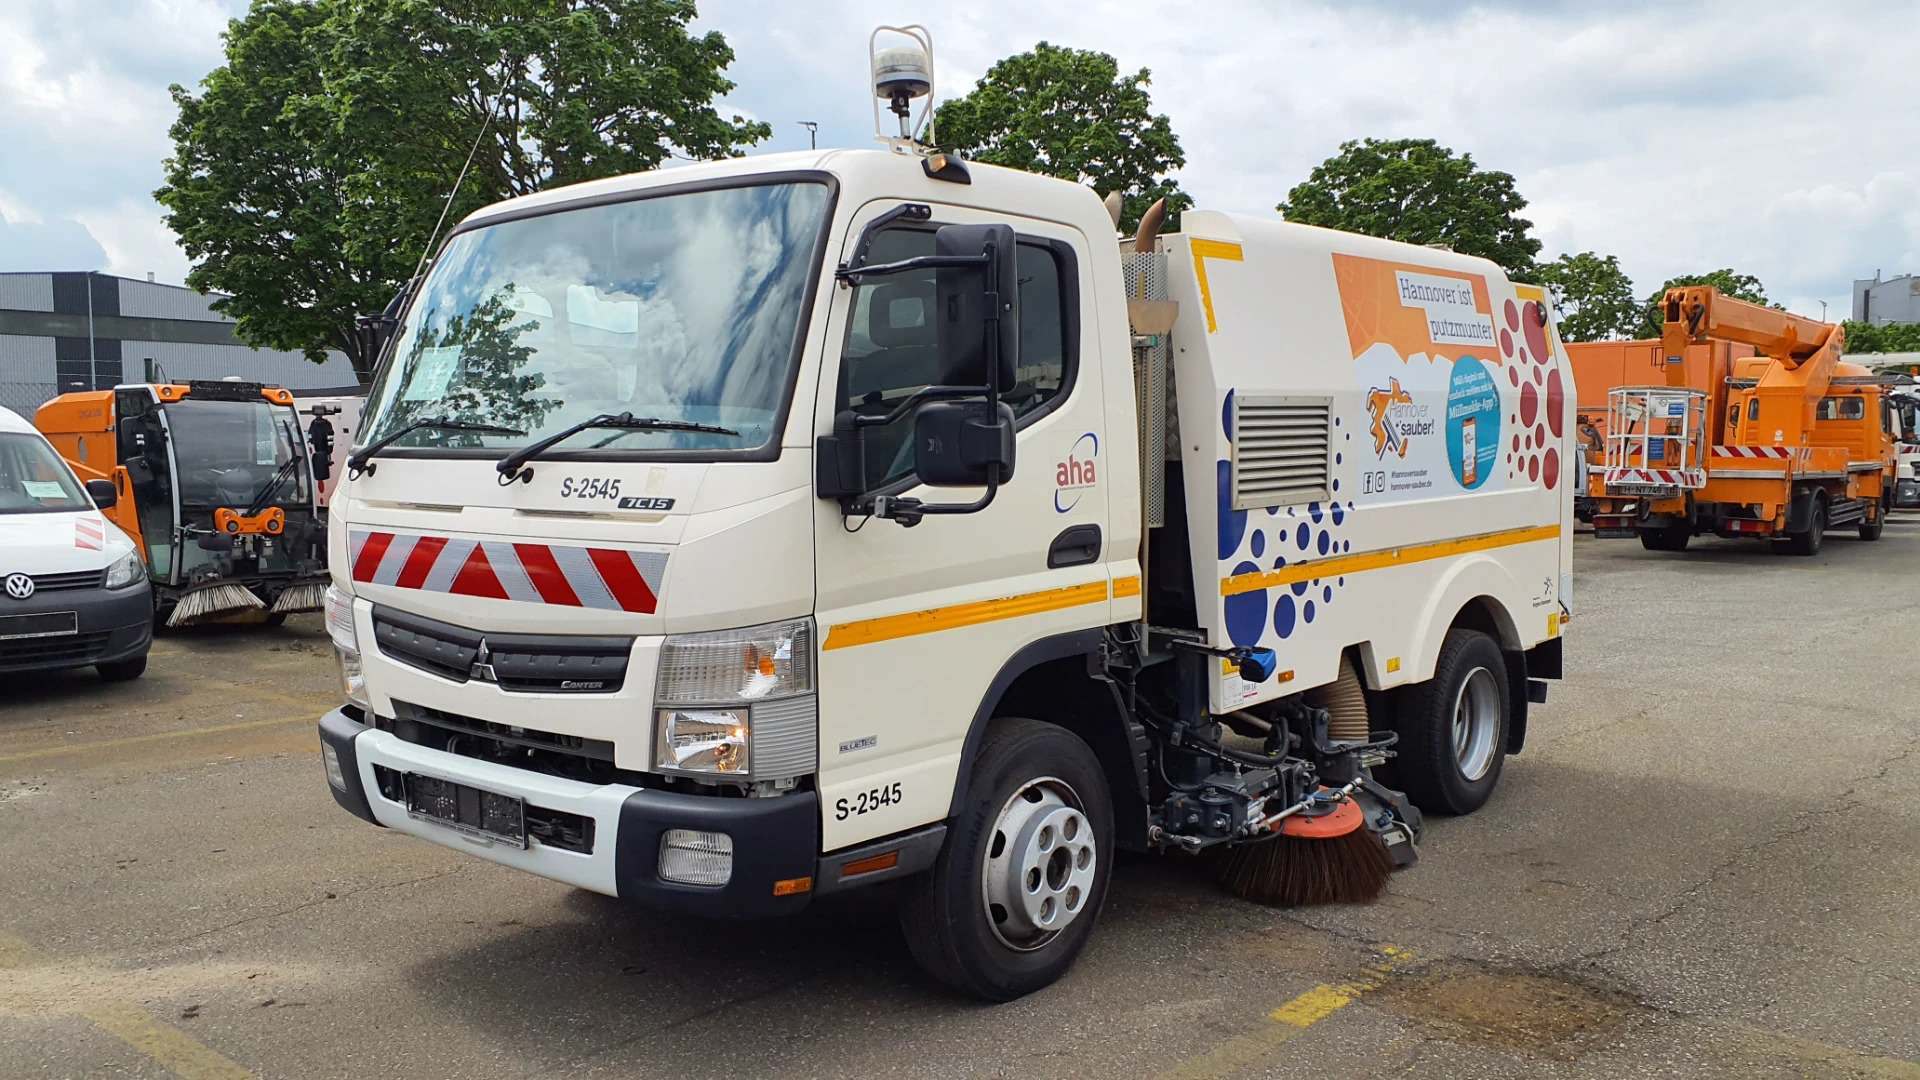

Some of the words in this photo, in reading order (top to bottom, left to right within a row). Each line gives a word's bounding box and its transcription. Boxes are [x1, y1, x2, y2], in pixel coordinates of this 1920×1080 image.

[1399, 278, 1456, 304] Hannover
[1457, 284, 1473, 306] ist
[1430, 319, 1492, 341] putzmunter
[1389, 399, 1429, 418] Hannover
[1056, 453, 1096, 486] aha
[560, 477, 621, 500] S-2545
[835, 782, 902, 821] S-2545
